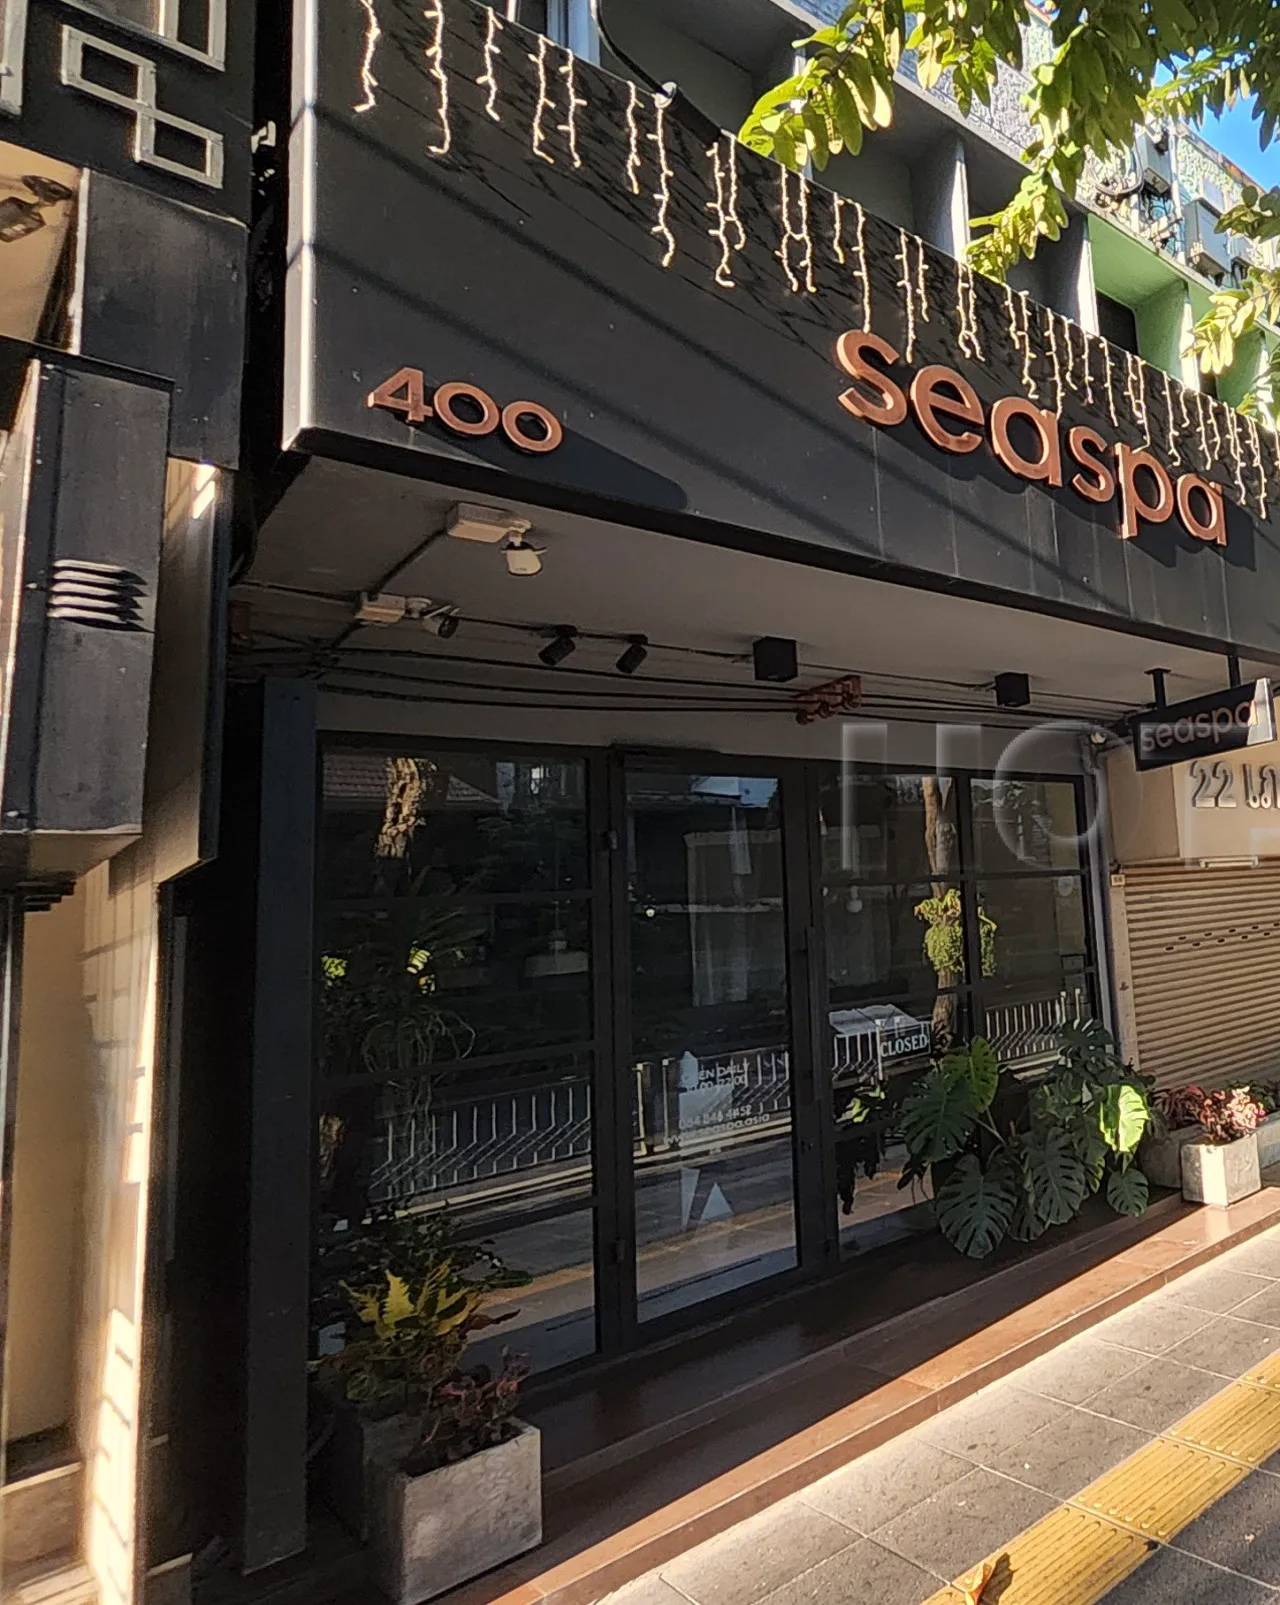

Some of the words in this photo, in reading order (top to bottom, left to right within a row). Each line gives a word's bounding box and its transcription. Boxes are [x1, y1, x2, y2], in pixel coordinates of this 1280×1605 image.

[367, 366, 564, 455] 400
[836, 329, 1227, 547] seaspa
[1140, 698, 1258, 754] seaspa
[1189, 759, 1238, 809] 22
[880, 1033, 928, 1057] CLOSED
